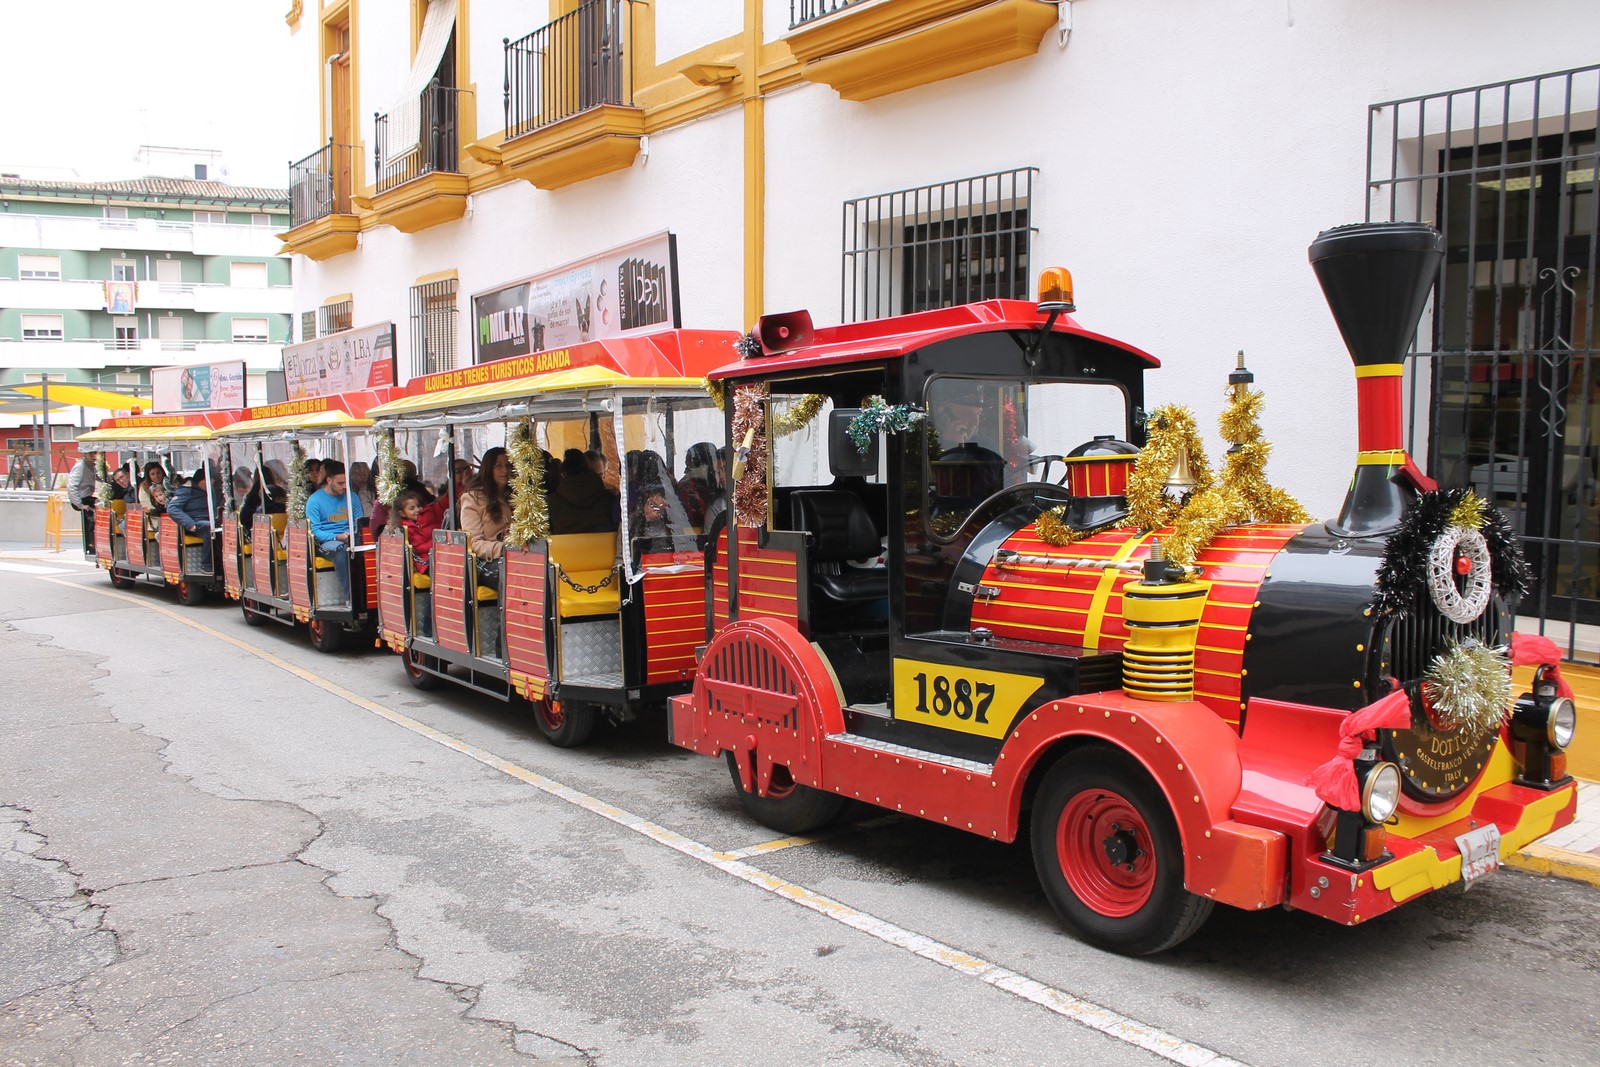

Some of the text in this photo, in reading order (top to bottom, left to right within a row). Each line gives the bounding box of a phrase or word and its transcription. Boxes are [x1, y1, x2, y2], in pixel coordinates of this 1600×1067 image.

[489, 306, 525, 344] MILAR
[353, 337, 371, 360] LBA
[424, 350, 571, 392] ALQUILER DE TRENES TURISTICOS ARANDA
[277, 402, 299, 416] CONTACTO
[913, 672, 995, 724] 1887
[1431, 730, 1469, 756] DOTTO
[1416, 747, 1463, 771] CASTELFRANCO
[1444, 769, 1462, 782] ITALY
